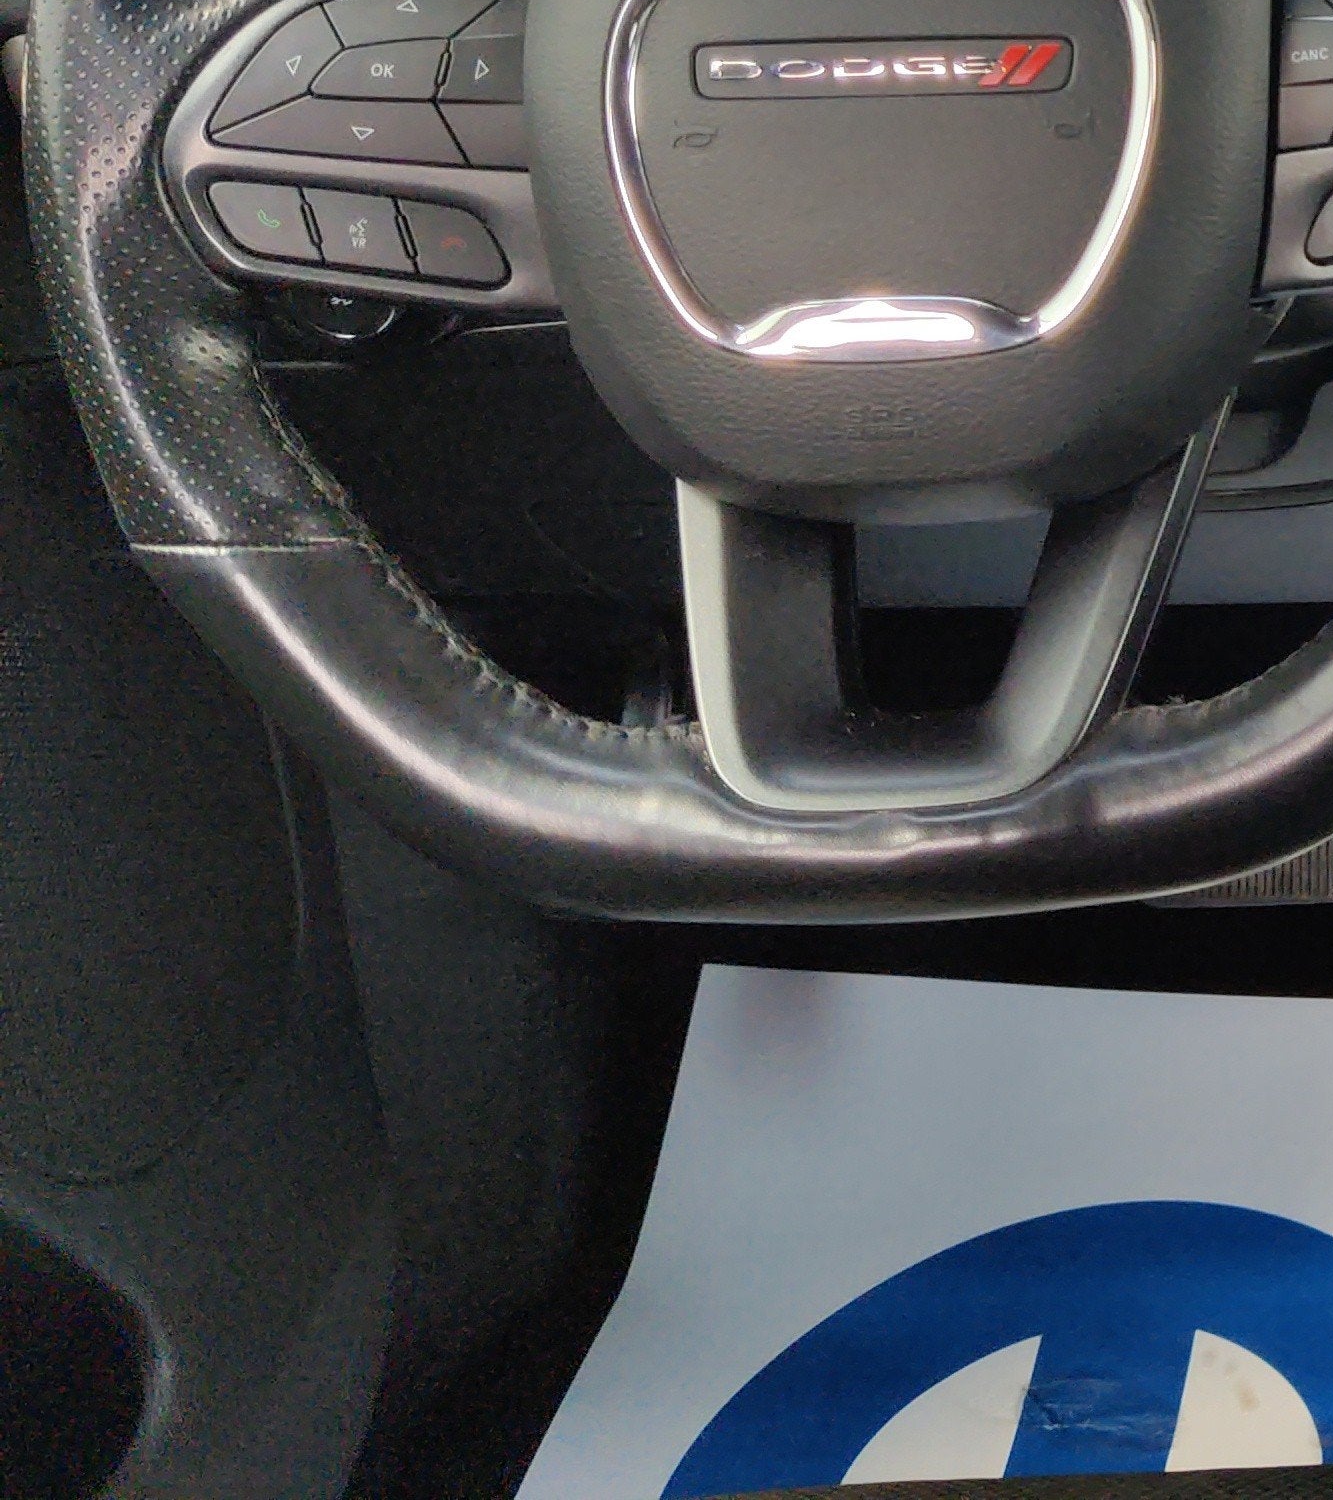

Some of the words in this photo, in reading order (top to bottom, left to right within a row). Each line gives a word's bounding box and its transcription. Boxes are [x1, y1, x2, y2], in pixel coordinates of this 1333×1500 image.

[1291, 47, 1329, 62] CANC
[370, 62, 394, 78] OK
[709, 56, 1007, 80] DODGE
